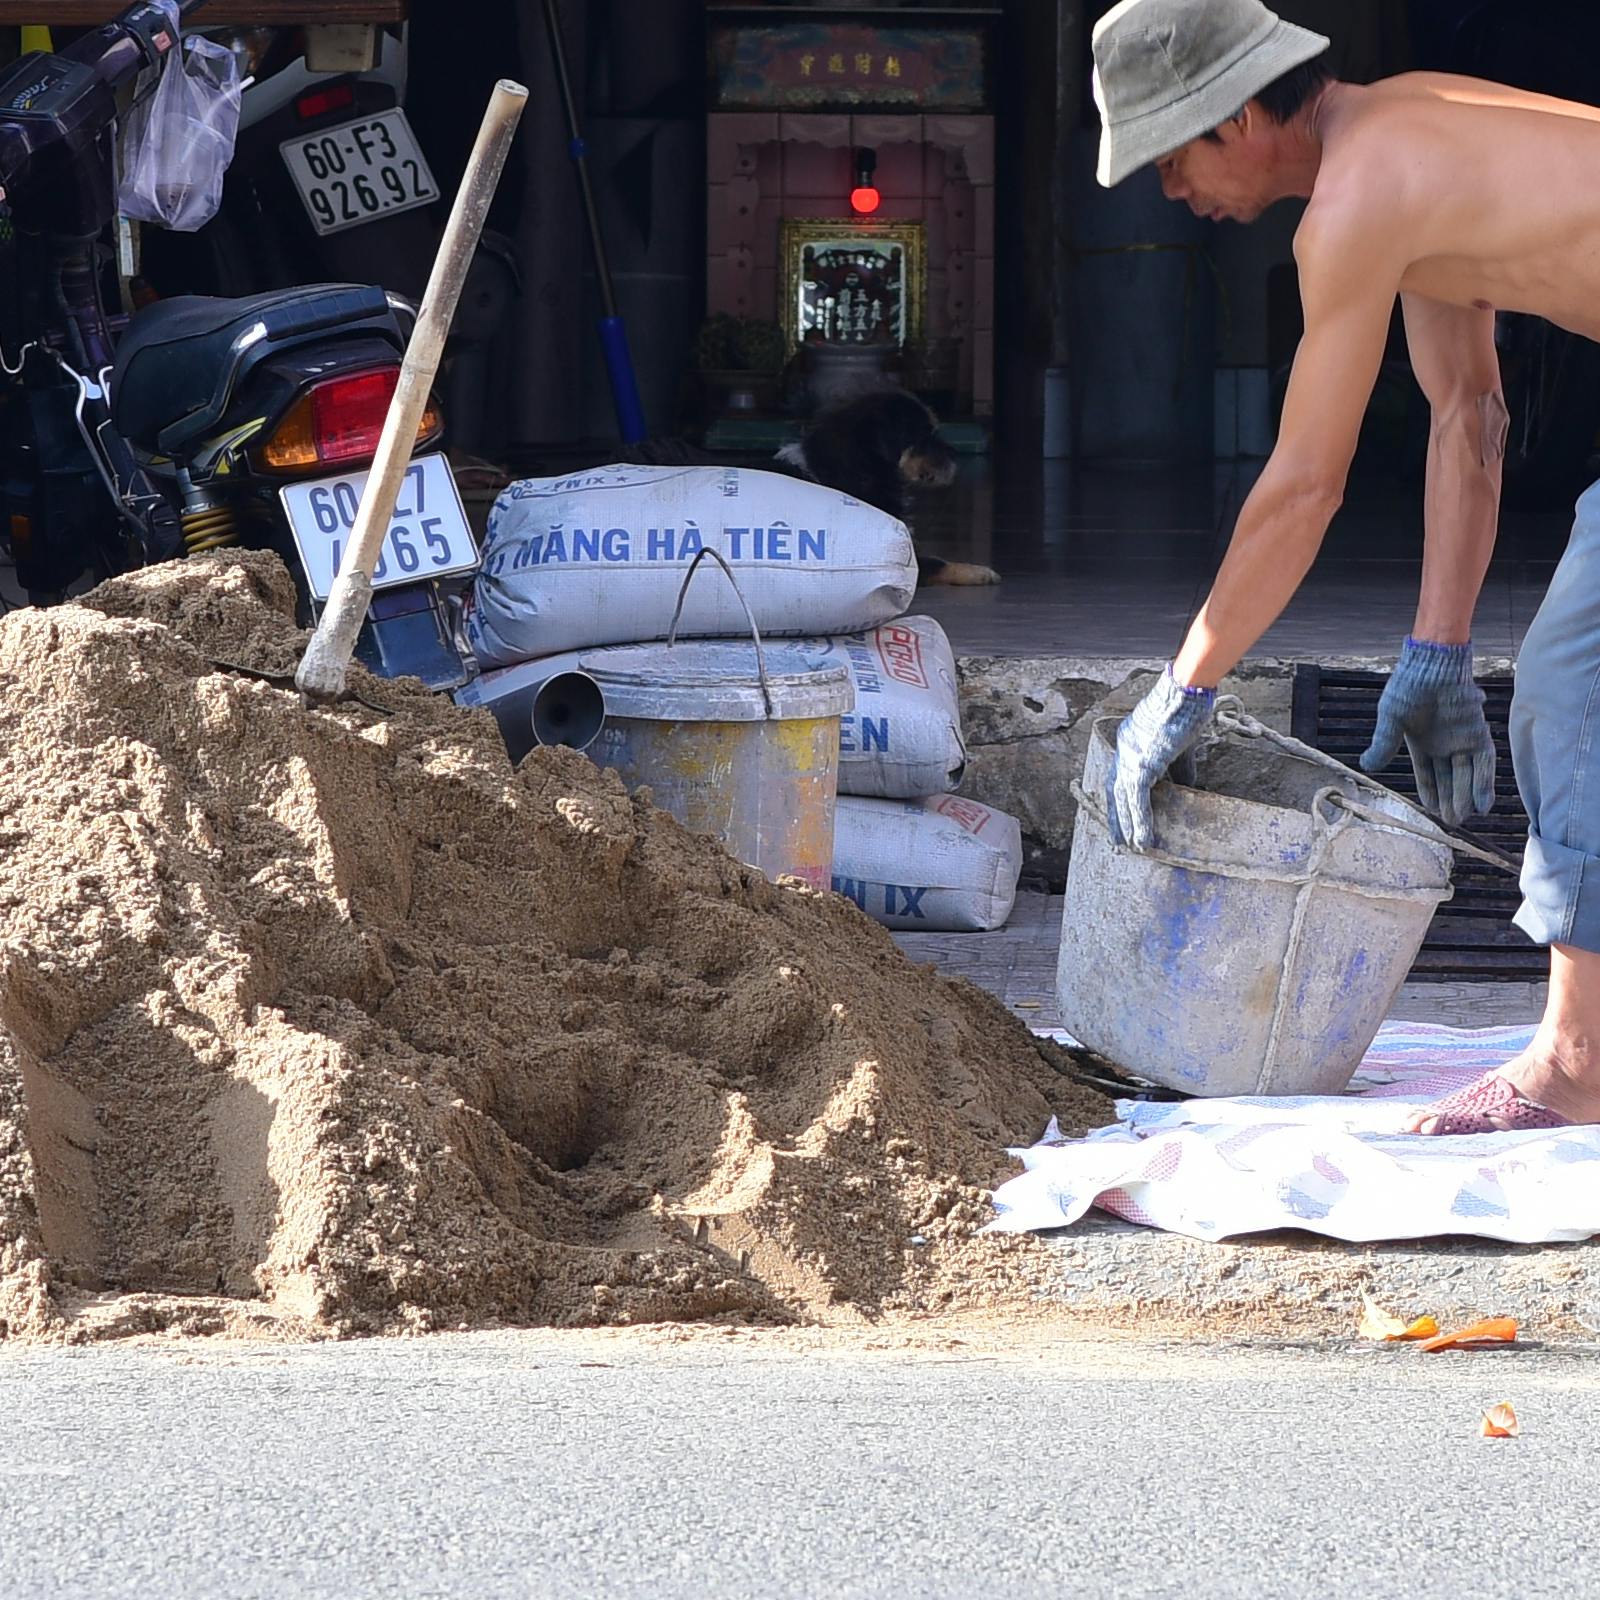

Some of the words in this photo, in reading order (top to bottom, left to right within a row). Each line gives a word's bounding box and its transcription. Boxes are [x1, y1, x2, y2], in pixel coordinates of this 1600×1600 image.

[301, 121, 398, 181] 60-F3
[309, 158, 431, 227] 926.92
[308, 464, 425, 534] 607
[331, 516, 452, 579] 65
[512, 521, 630, 570] MĂNG
[647, 519, 705, 560] HÀ
[723, 520, 826, 561] TIÊN
